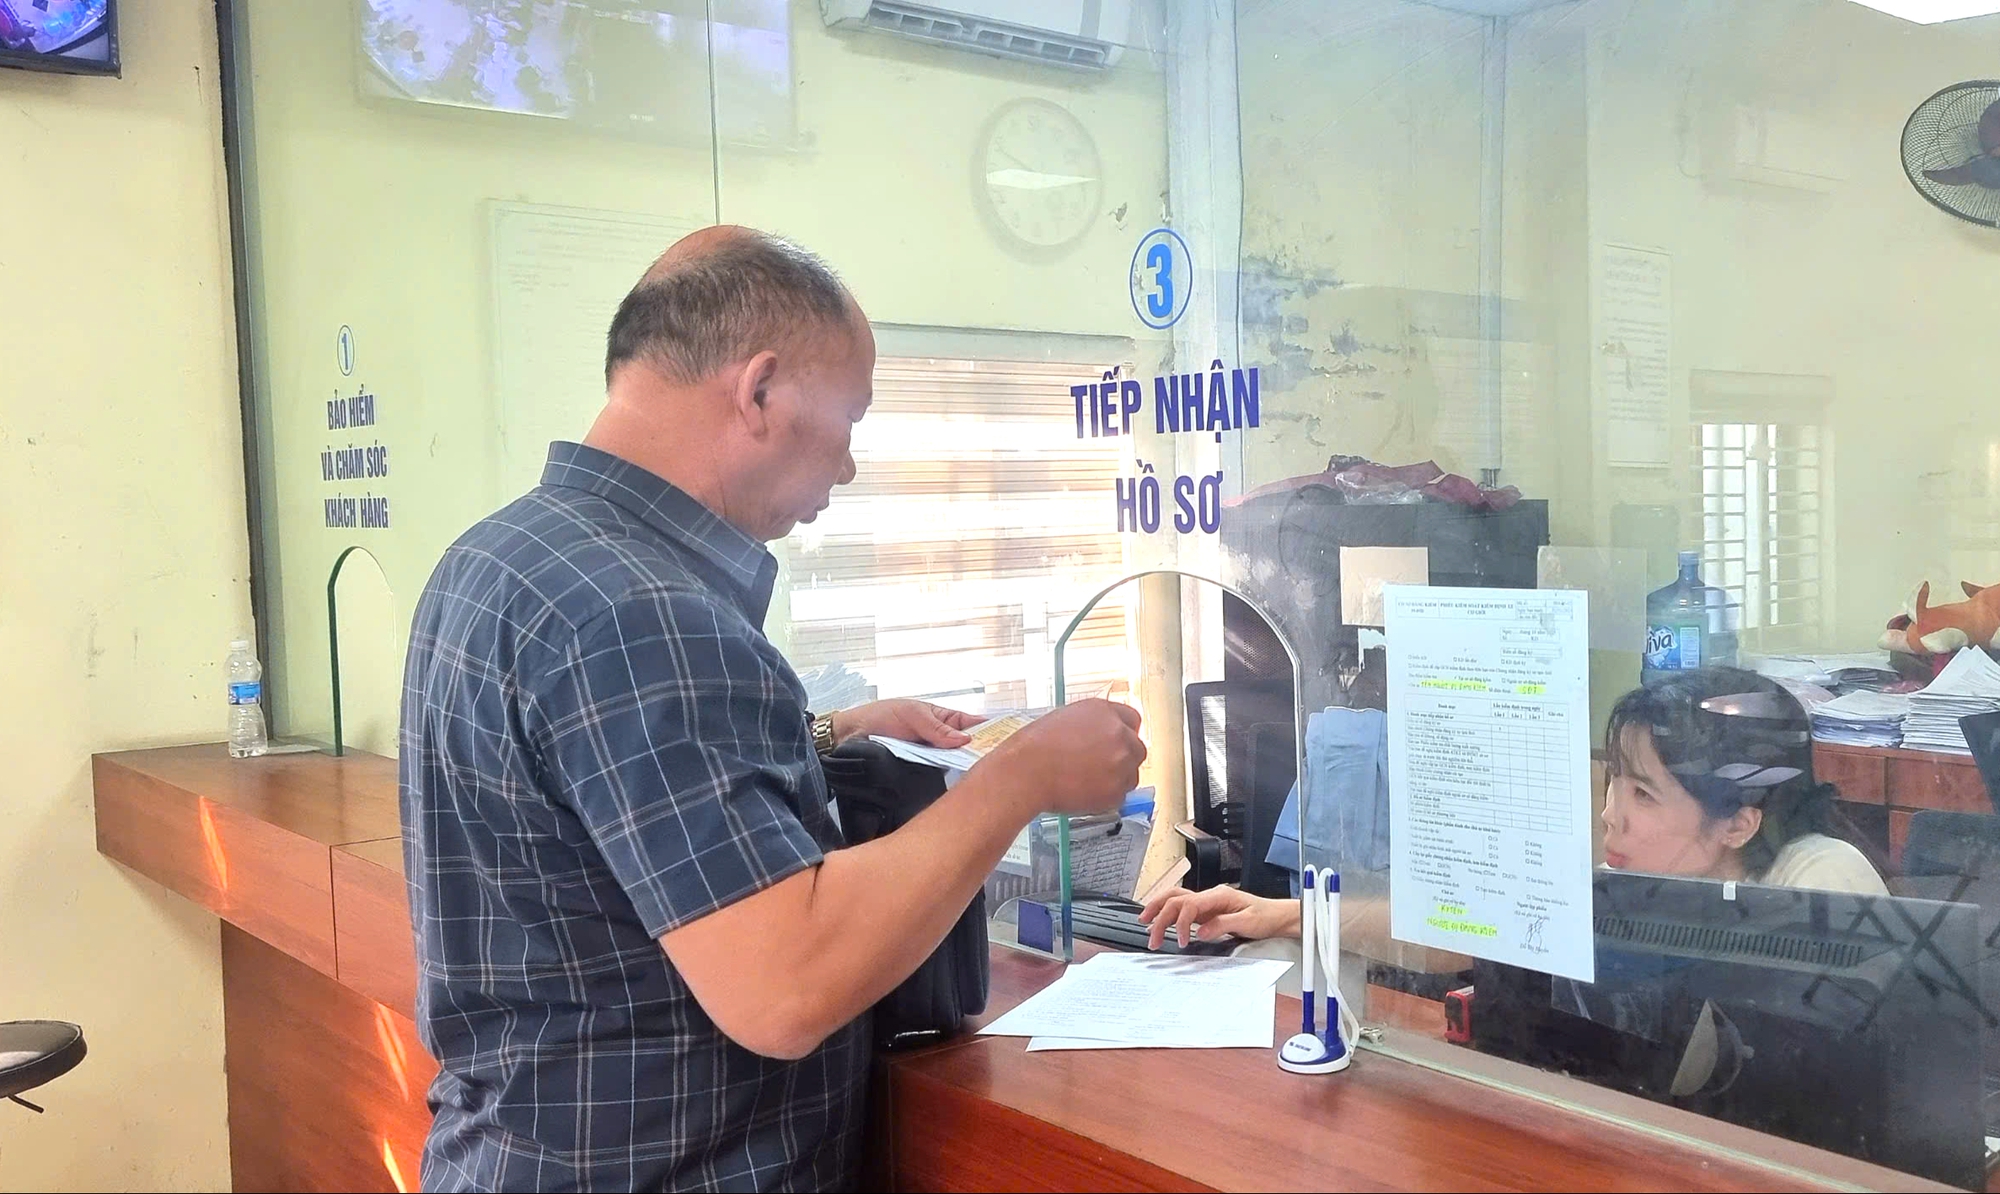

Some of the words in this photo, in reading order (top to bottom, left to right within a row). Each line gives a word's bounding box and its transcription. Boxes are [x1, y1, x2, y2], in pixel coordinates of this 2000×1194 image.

[1146, 243, 1174, 318] 3
[341, 333, 349, 370] 1
[327, 389, 347, 430] BẢO
[348, 383, 375, 428] HIỂM
[1070, 365, 1142, 439] TIẾP
[1154, 358, 1260, 443] NHẬN
[321, 445, 334, 481] VÀ
[335, 443, 364, 480] CHĂM
[366, 439, 388, 478] SÓC
[324, 492, 357, 528] KHÁCH
[360, 491, 389, 528] HÀNG
[1116, 459, 1160, 534] HỒ
[1173, 470, 1224, 534] SƠ
